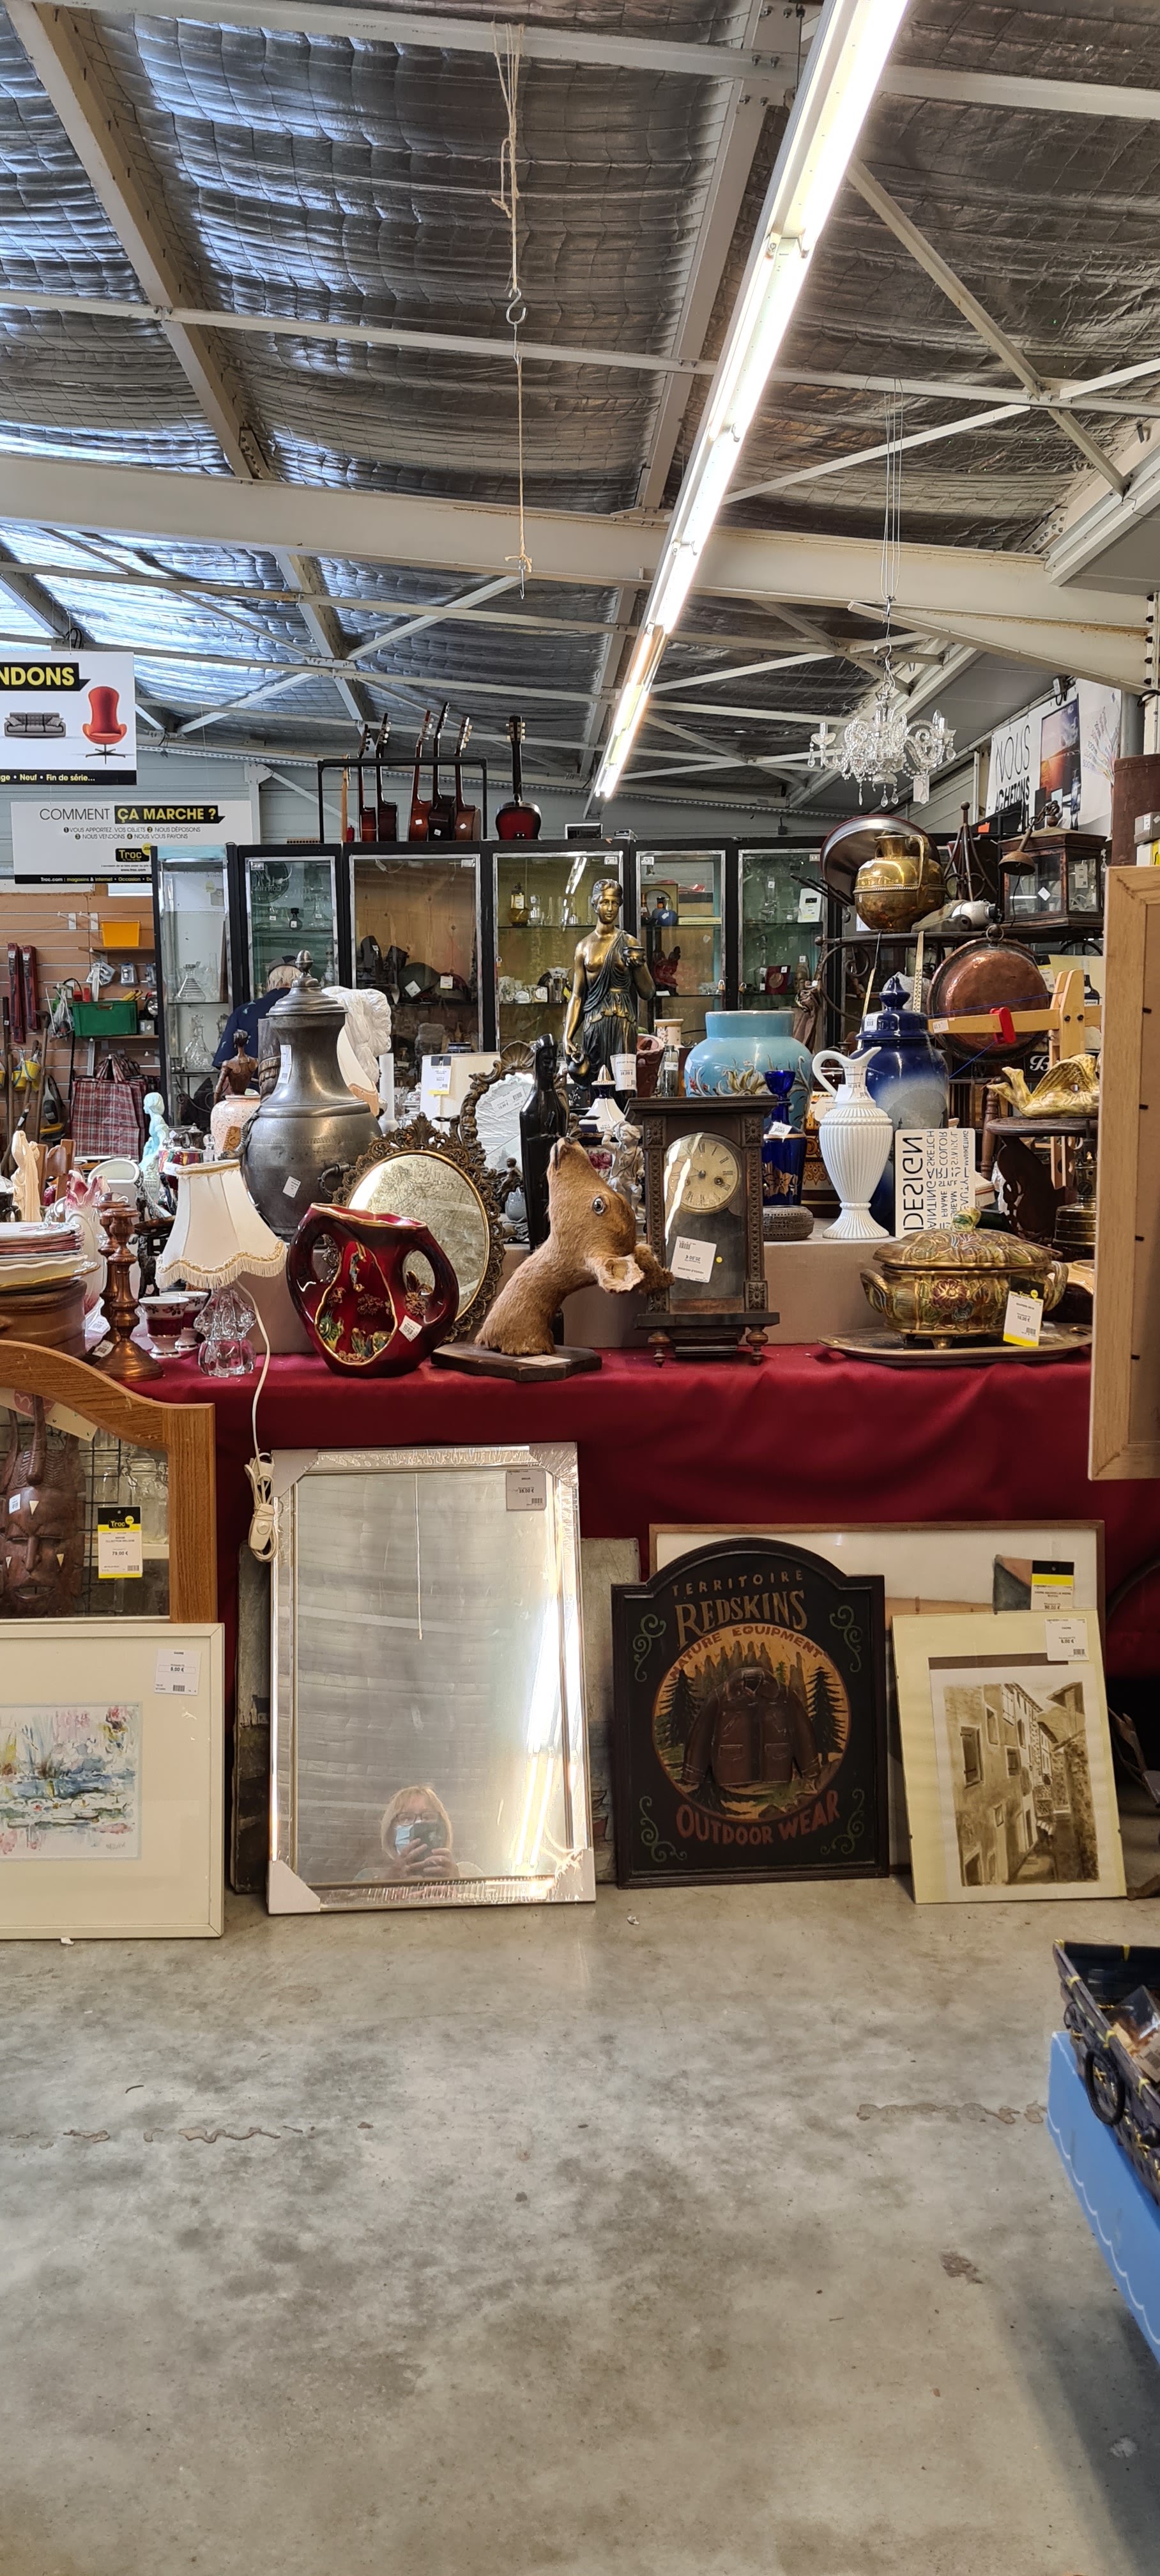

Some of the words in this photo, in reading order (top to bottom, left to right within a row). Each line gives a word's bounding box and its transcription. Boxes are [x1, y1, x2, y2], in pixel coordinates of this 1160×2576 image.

[995, 724, 1030, 786] NOUS
[40, 808, 110, 820] COMMENT
[117, 808, 139, 824] ÇA
[143, 808, 204, 820] MARCHE
[208, 808, 216, 820] ?
[995, 774, 1030, 814] ACHETONS
[118, 849, 142, 859] Troc
[672, 1570, 803, 1597] TERRITOIRE
[675, 1590, 807, 1651] REDSKINS
[669, 1632, 722, 1680] NATURE
[731, 1625, 824, 1659] EQUIPMENT
[675, 1804, 774, 1846] OUTDOOR
[777, 1790, 840, 1841] WEAR
